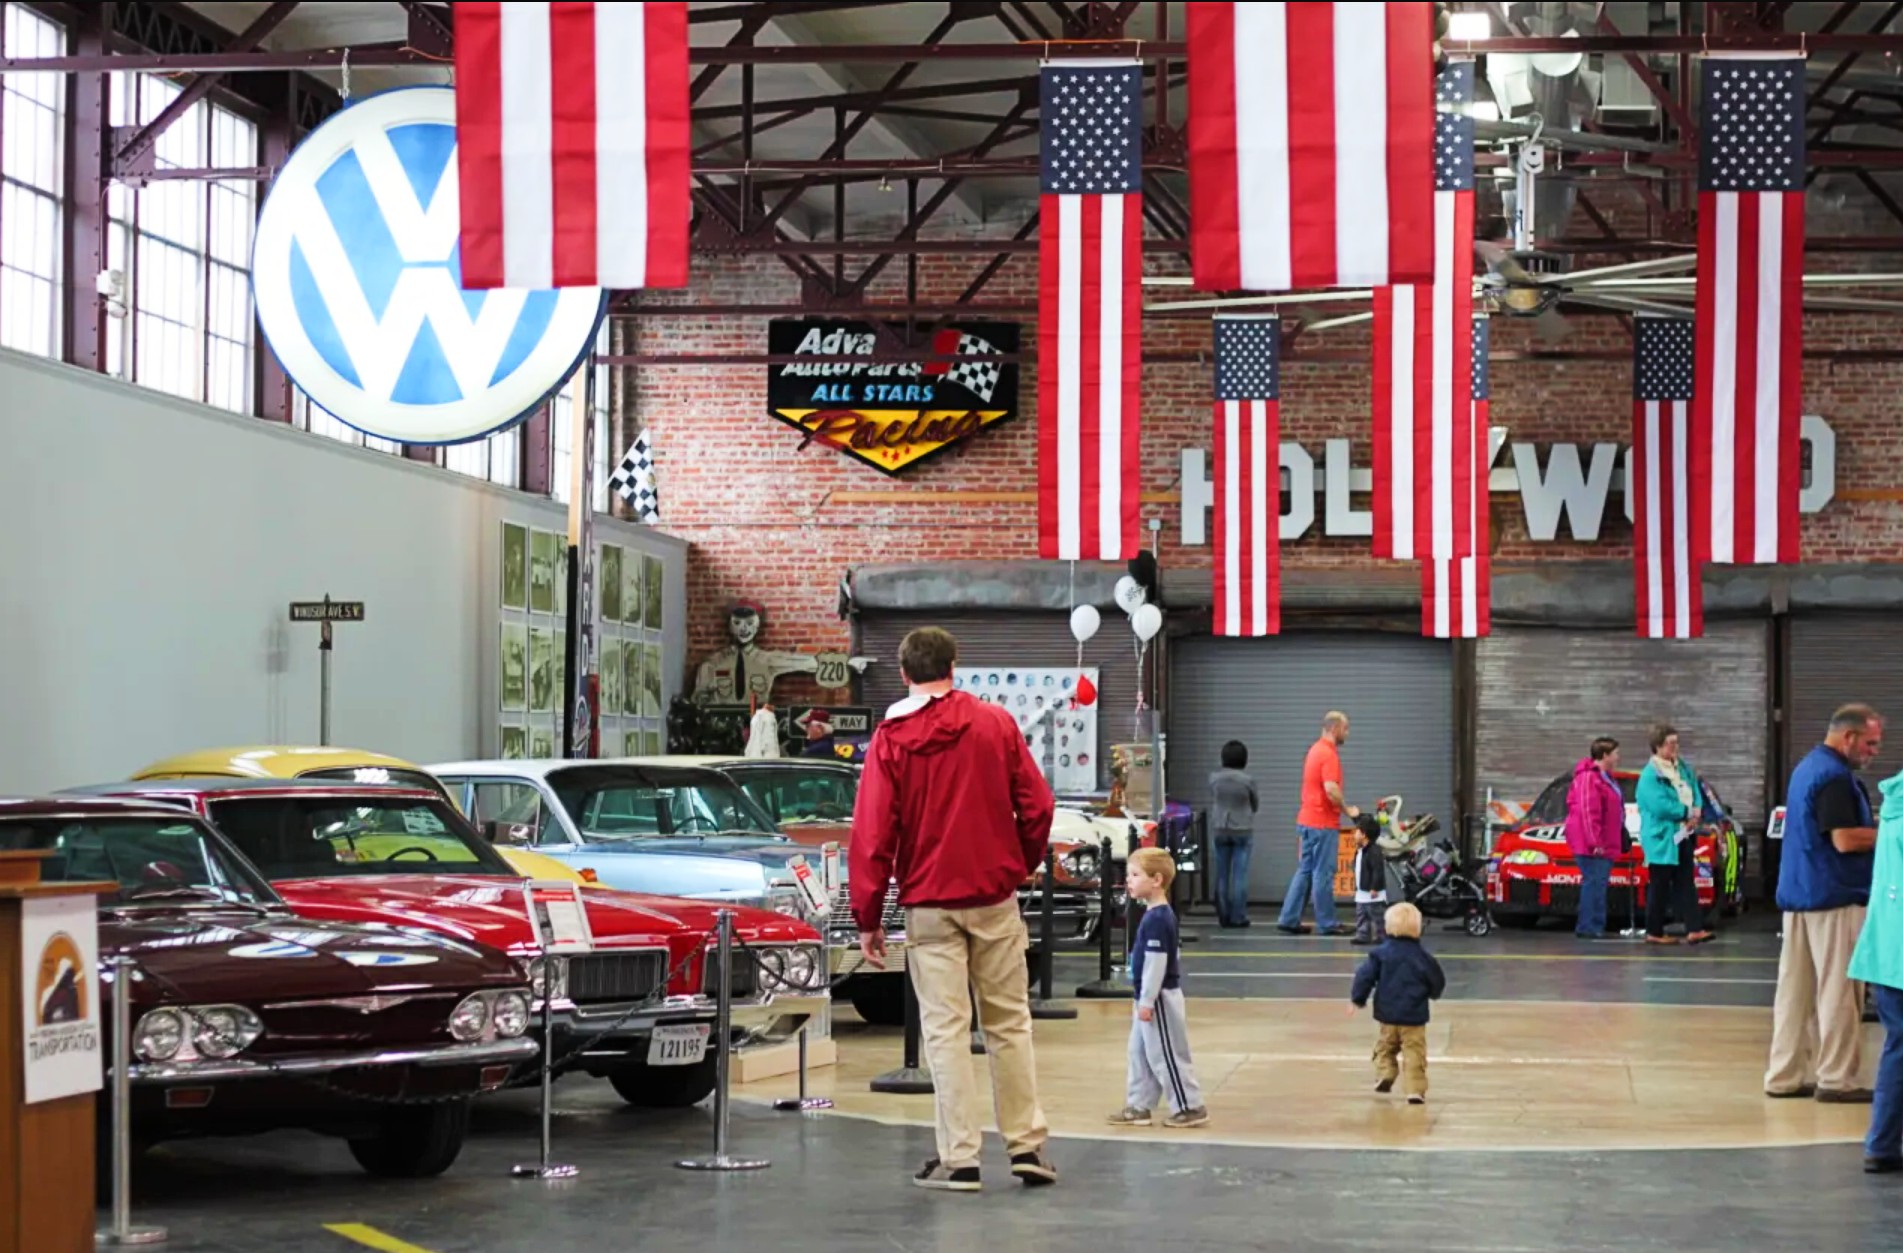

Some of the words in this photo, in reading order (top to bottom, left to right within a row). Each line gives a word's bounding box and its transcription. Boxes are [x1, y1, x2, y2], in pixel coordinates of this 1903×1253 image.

[811, 384, 853, 402] ALL
[863, 384, 935, 402] STARS
[798, 410, 983, 454] Racing
[820, 661, 844, 682] 220
[840, 715, 865, 729] WAY
[1546, 873, 1584, 885] MONT
[661, 1038, 701, 1059] 121195
